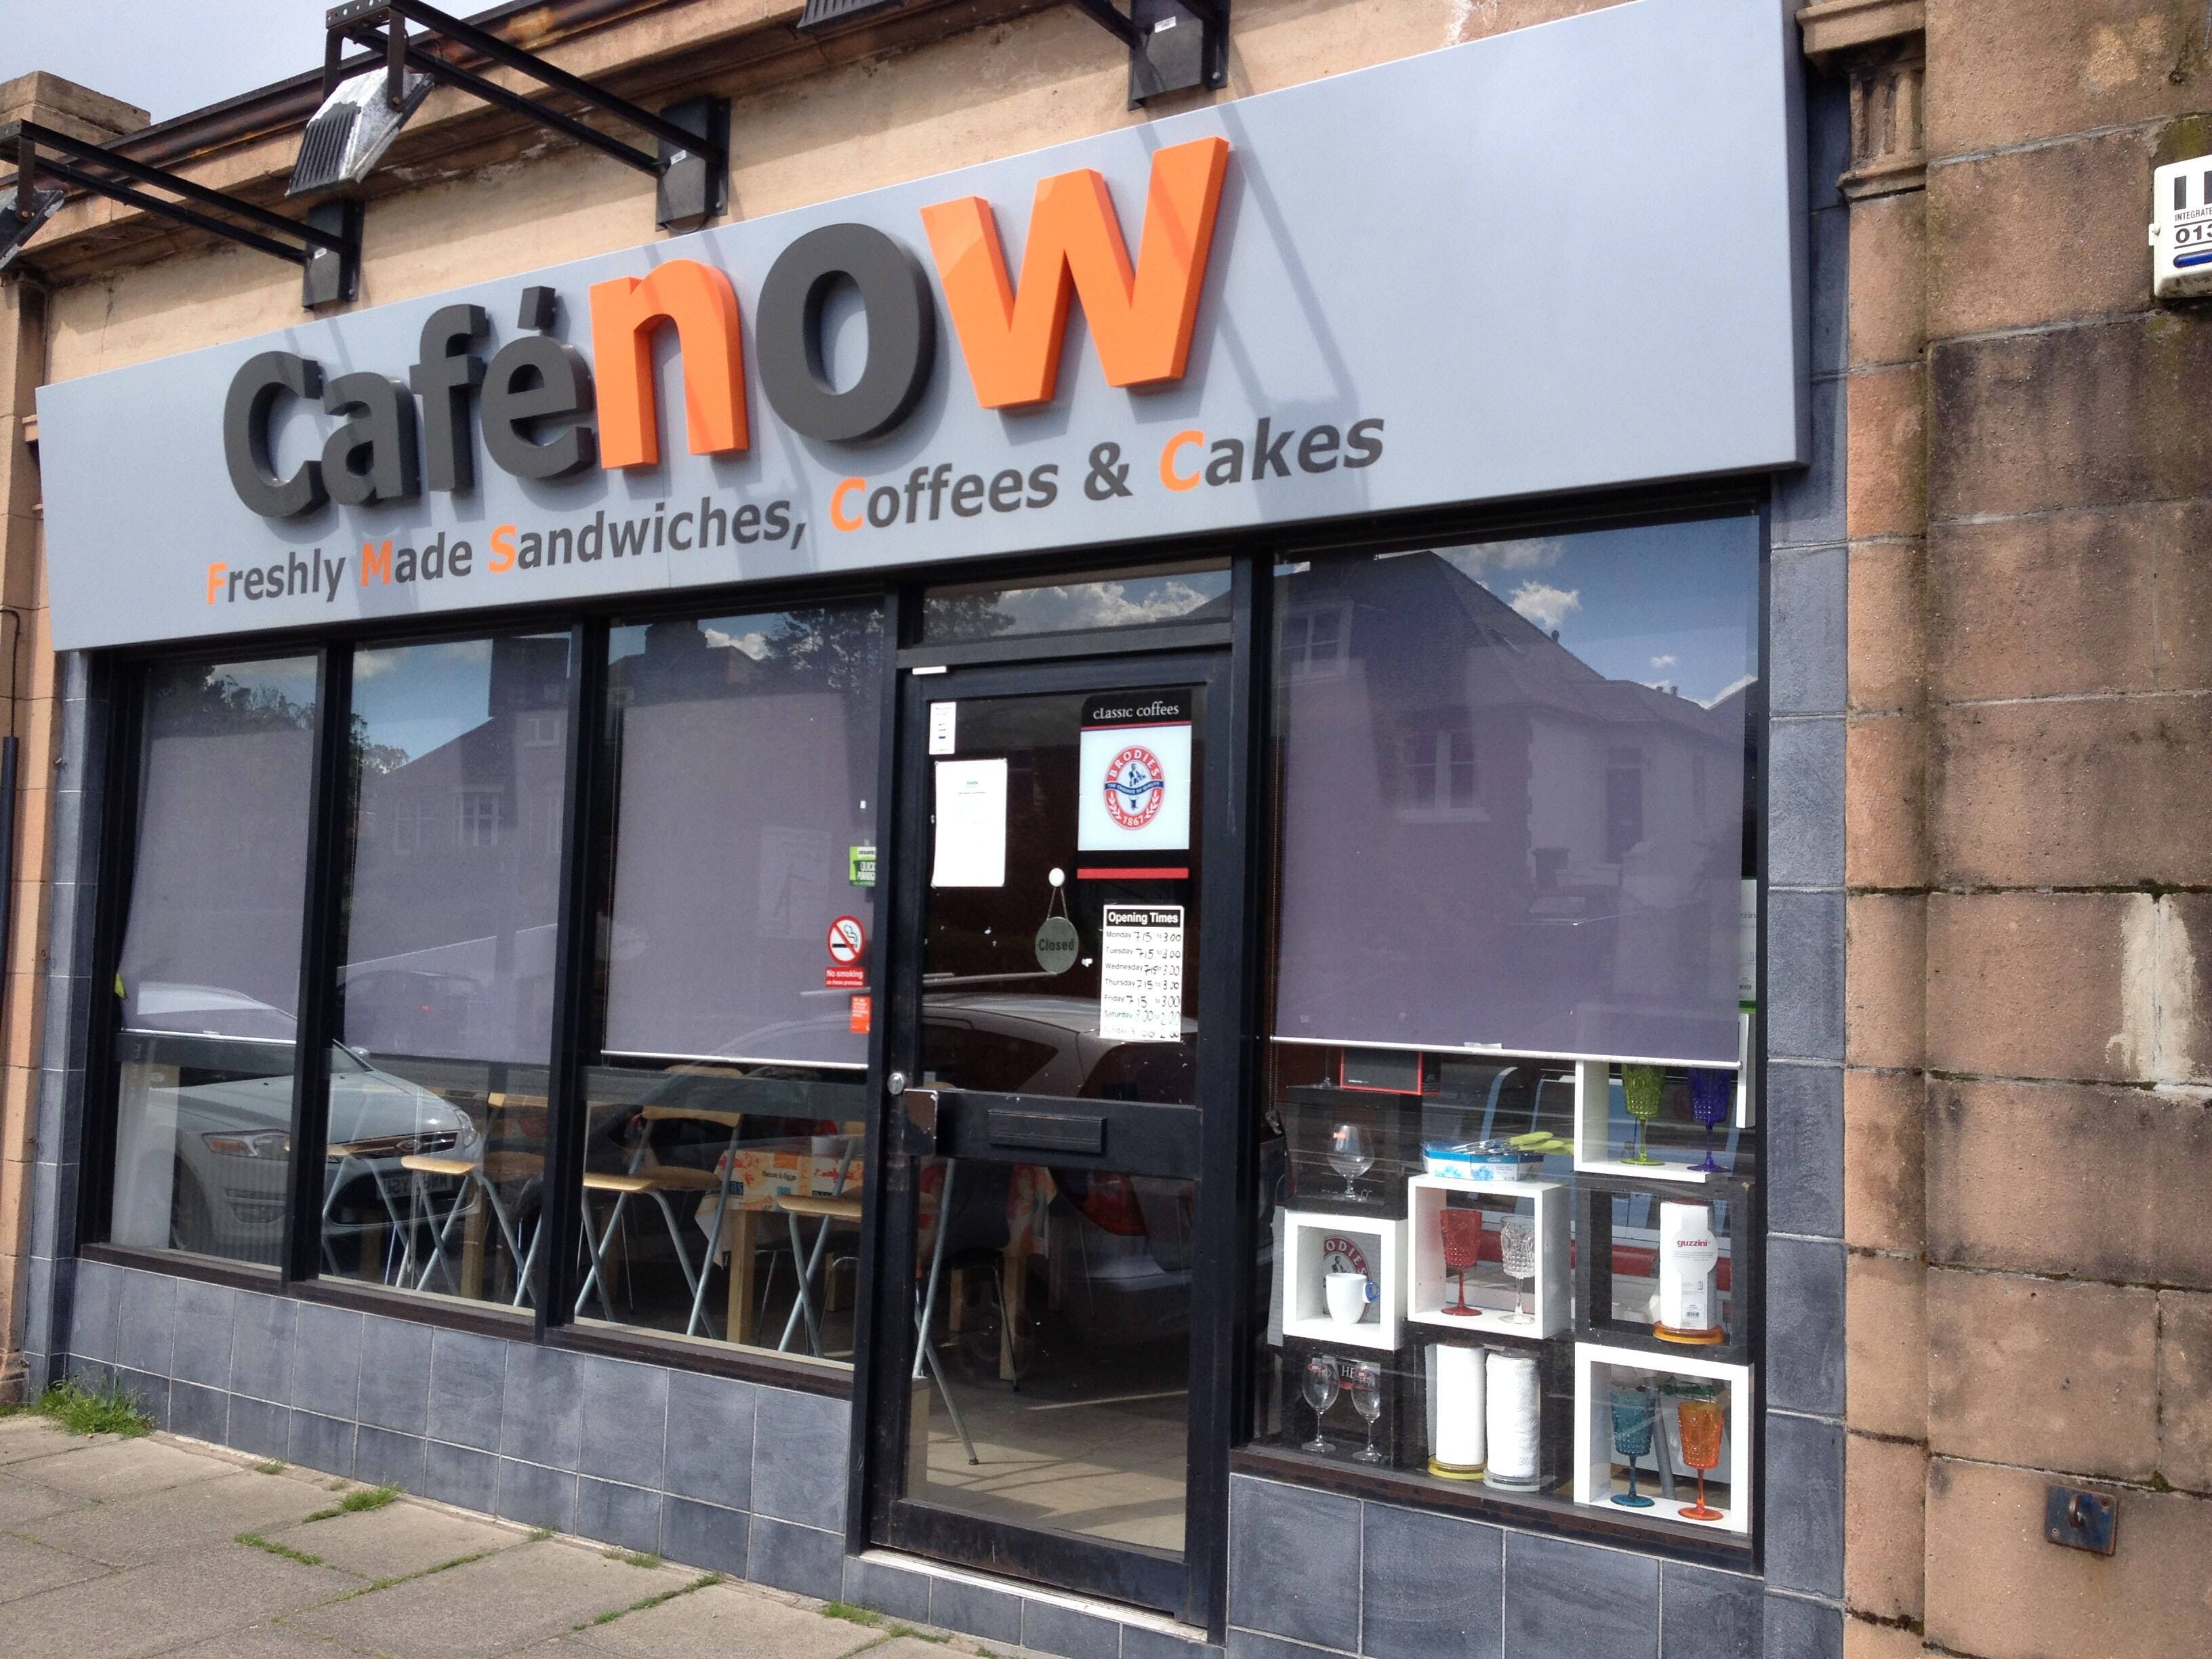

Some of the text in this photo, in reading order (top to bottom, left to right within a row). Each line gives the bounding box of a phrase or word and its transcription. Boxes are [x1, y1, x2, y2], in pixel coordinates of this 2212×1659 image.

[206, 416, 1385, 605] Freshly Made Sandwiches, Coffees & Cakes
[1092, 701, 1179, 719] classic coffees
[1109, 750, 1160, 778] BRODIES
[1122, 815, 1145, 826] 1867
[1108, 912, 1179, 925] Opening Times
[1106, 931, 1131, 939] Monday
[1038, 939, 1074, 951] Closed
[1105, 963, 1143, 971] Wednesday
[836, 970, 863, 980] smoking
[1105, 978, 1135, 987] Thursday
[1105, 994, 1124, 1002] Friday
[1677, 1239, 1708, 1248] guzzini
